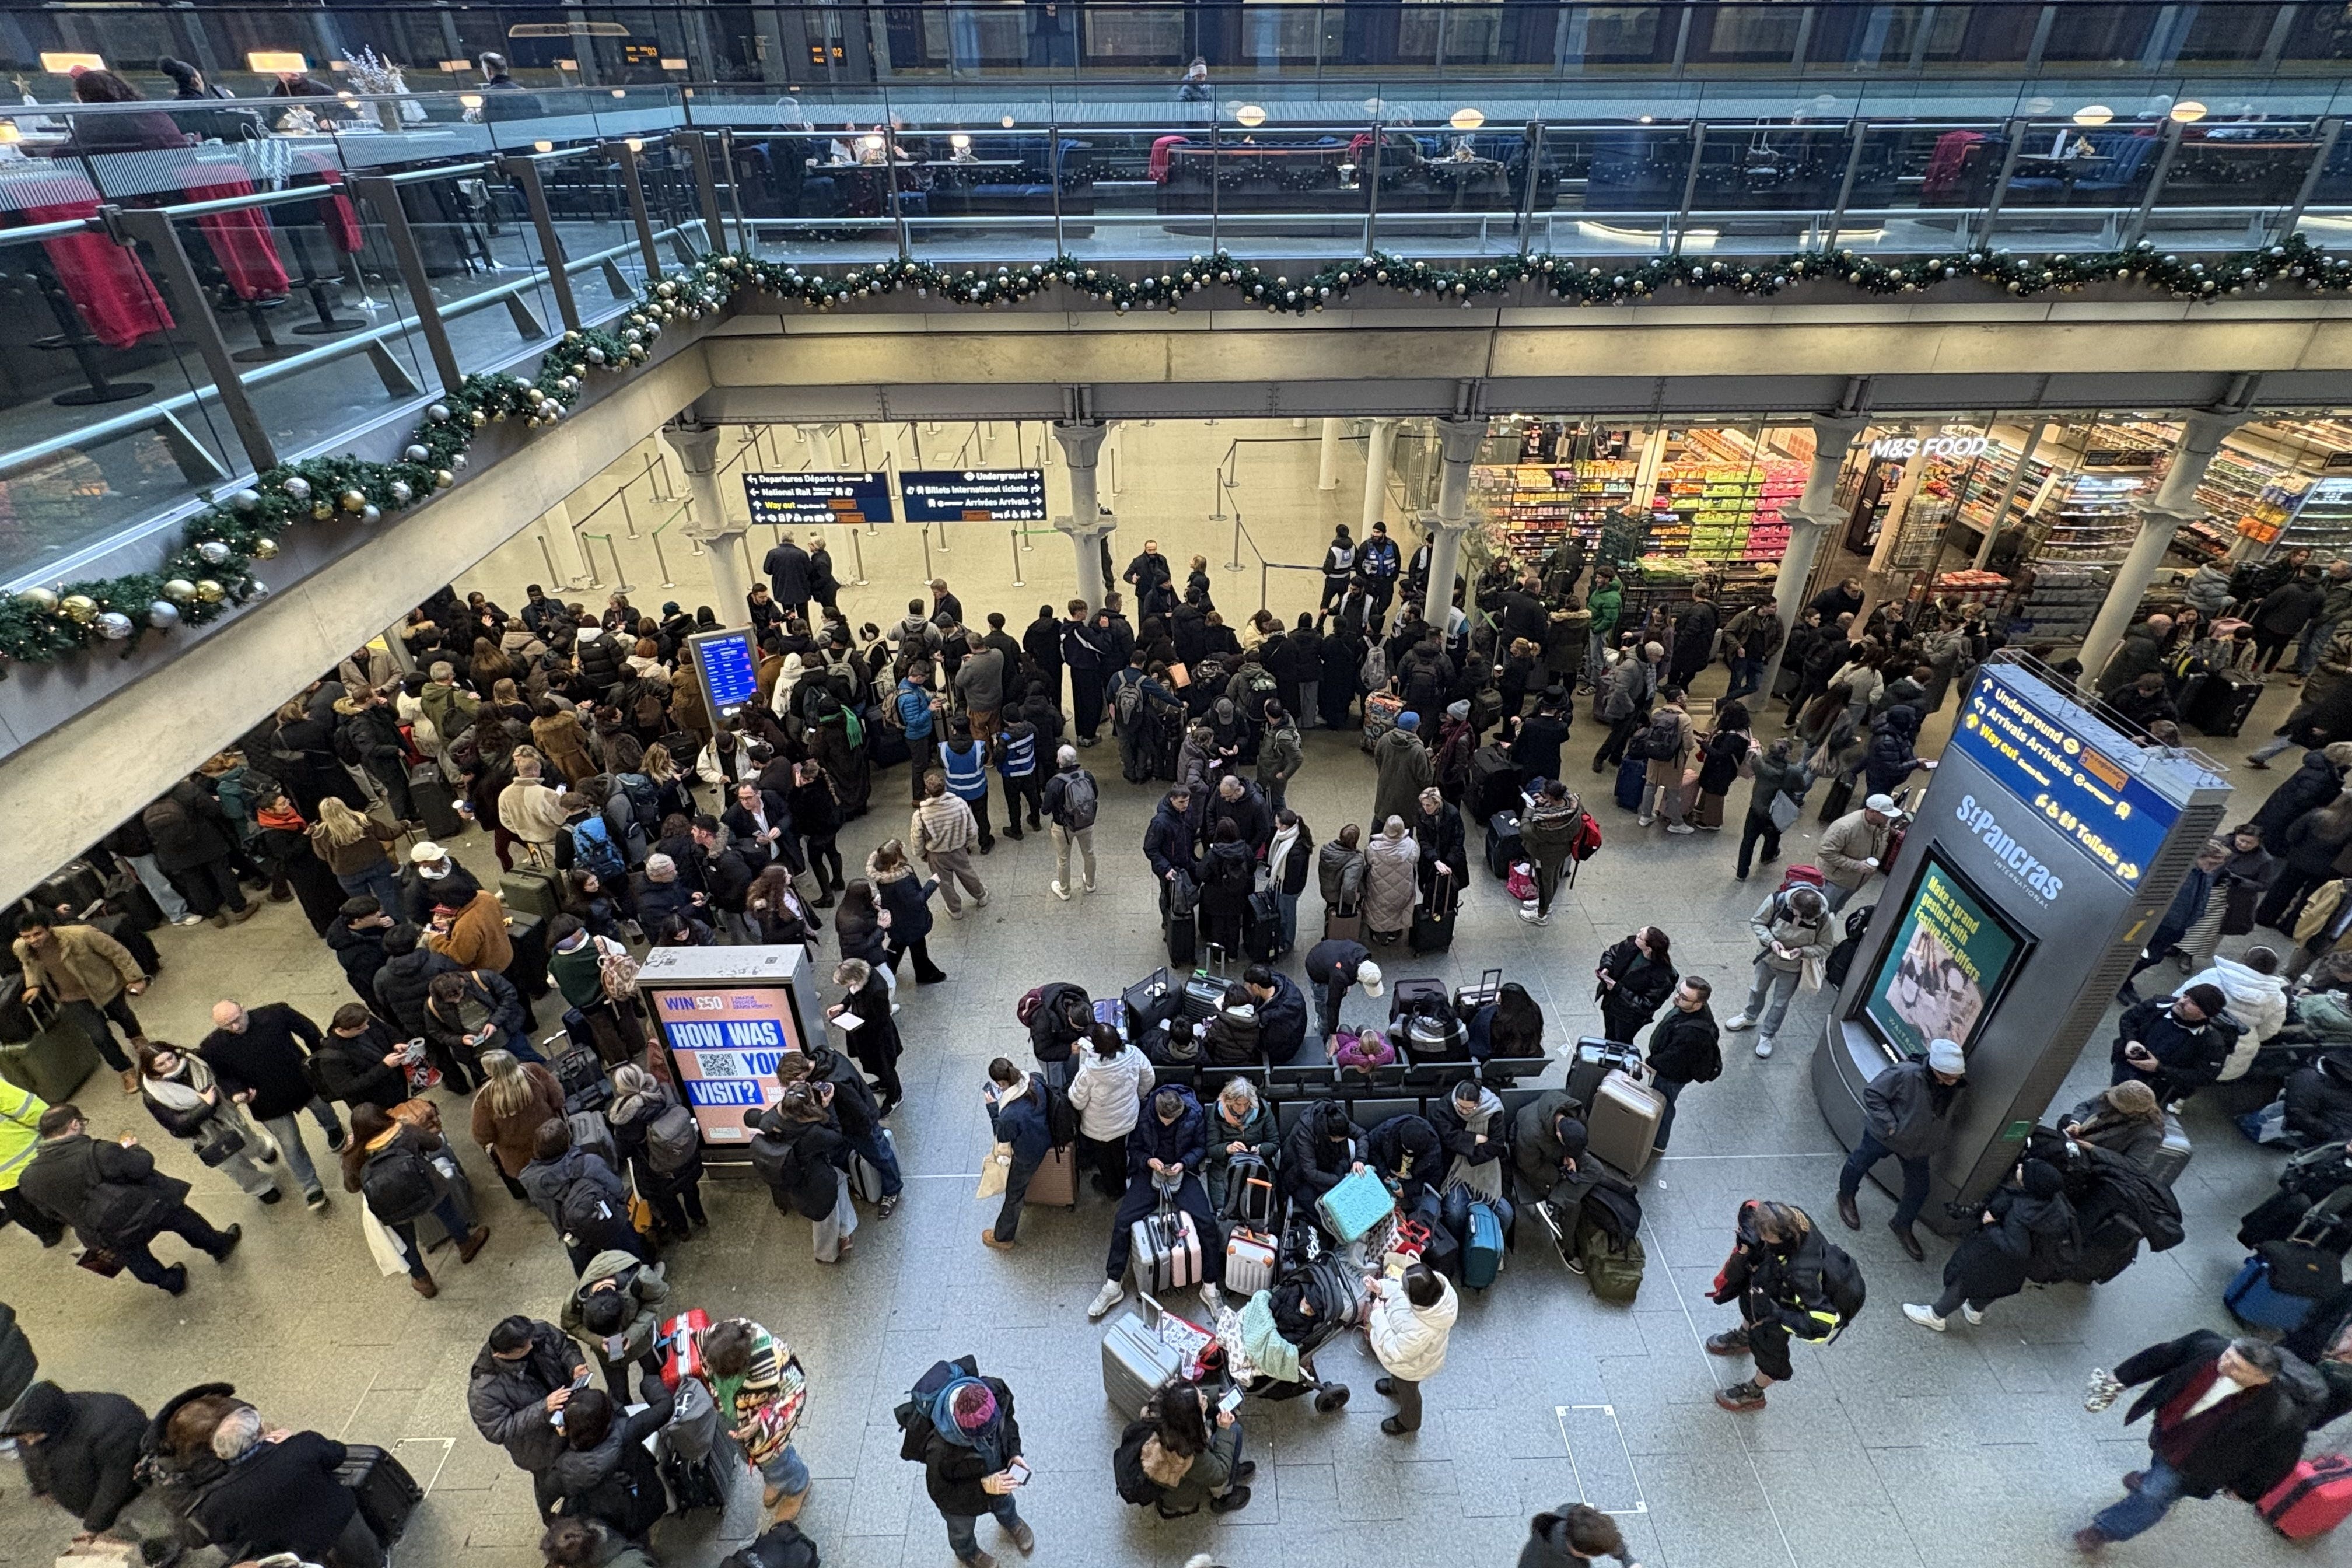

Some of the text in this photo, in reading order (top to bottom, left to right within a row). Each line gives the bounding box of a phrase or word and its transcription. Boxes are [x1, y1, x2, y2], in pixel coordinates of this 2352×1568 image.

[648, 47, 658, 57] 03
[832, 47, 843, 57] 02
[1870, 438, 1989, 458] M&S FOOD
[759, 475, 803, 484] Departures
[804, 474, 835, 484] Départs
[976, 472, 1028, 481] Underground
[796, 488, 811, 496] Rail
[925, 485, 1028, 494] Billets International tickets
[765, 501, 782, 510] Way
[965, 498, 998, 506] Arrivées
[999, 498, 1030, 506] Arrivals
[1995, 688, 2064, 744] Underground
[1980, 723, 2002, 748] Way
[2000, 743, 2019, 761] out
[1987, 707, 2073, 776] Arrivals Arrivées
[2115, 780, 2123, 790] C
[1972, 810, 2063, 901] Pancras
[2077, 824, 2119, 866] Toilets
[1993, 859, 2049, 909] INTERNATIONAL
[1927, 875, 1980, 935] Make a grand
[1920, 892, 1968, 946] gesture with
[1914, 905, 1980, 982] Festive Fizz Offers
[664, 997, 695, 1010] WIN
[696, 996, 723, 1010] £50
[671, 1022, 778, 1048] HOW WAS
[1889, 1017, 1920, 1053] WAITRO
[741, 1052, 786, 1075] YOU
[691, 1081, 756, 1104] VISIT?
